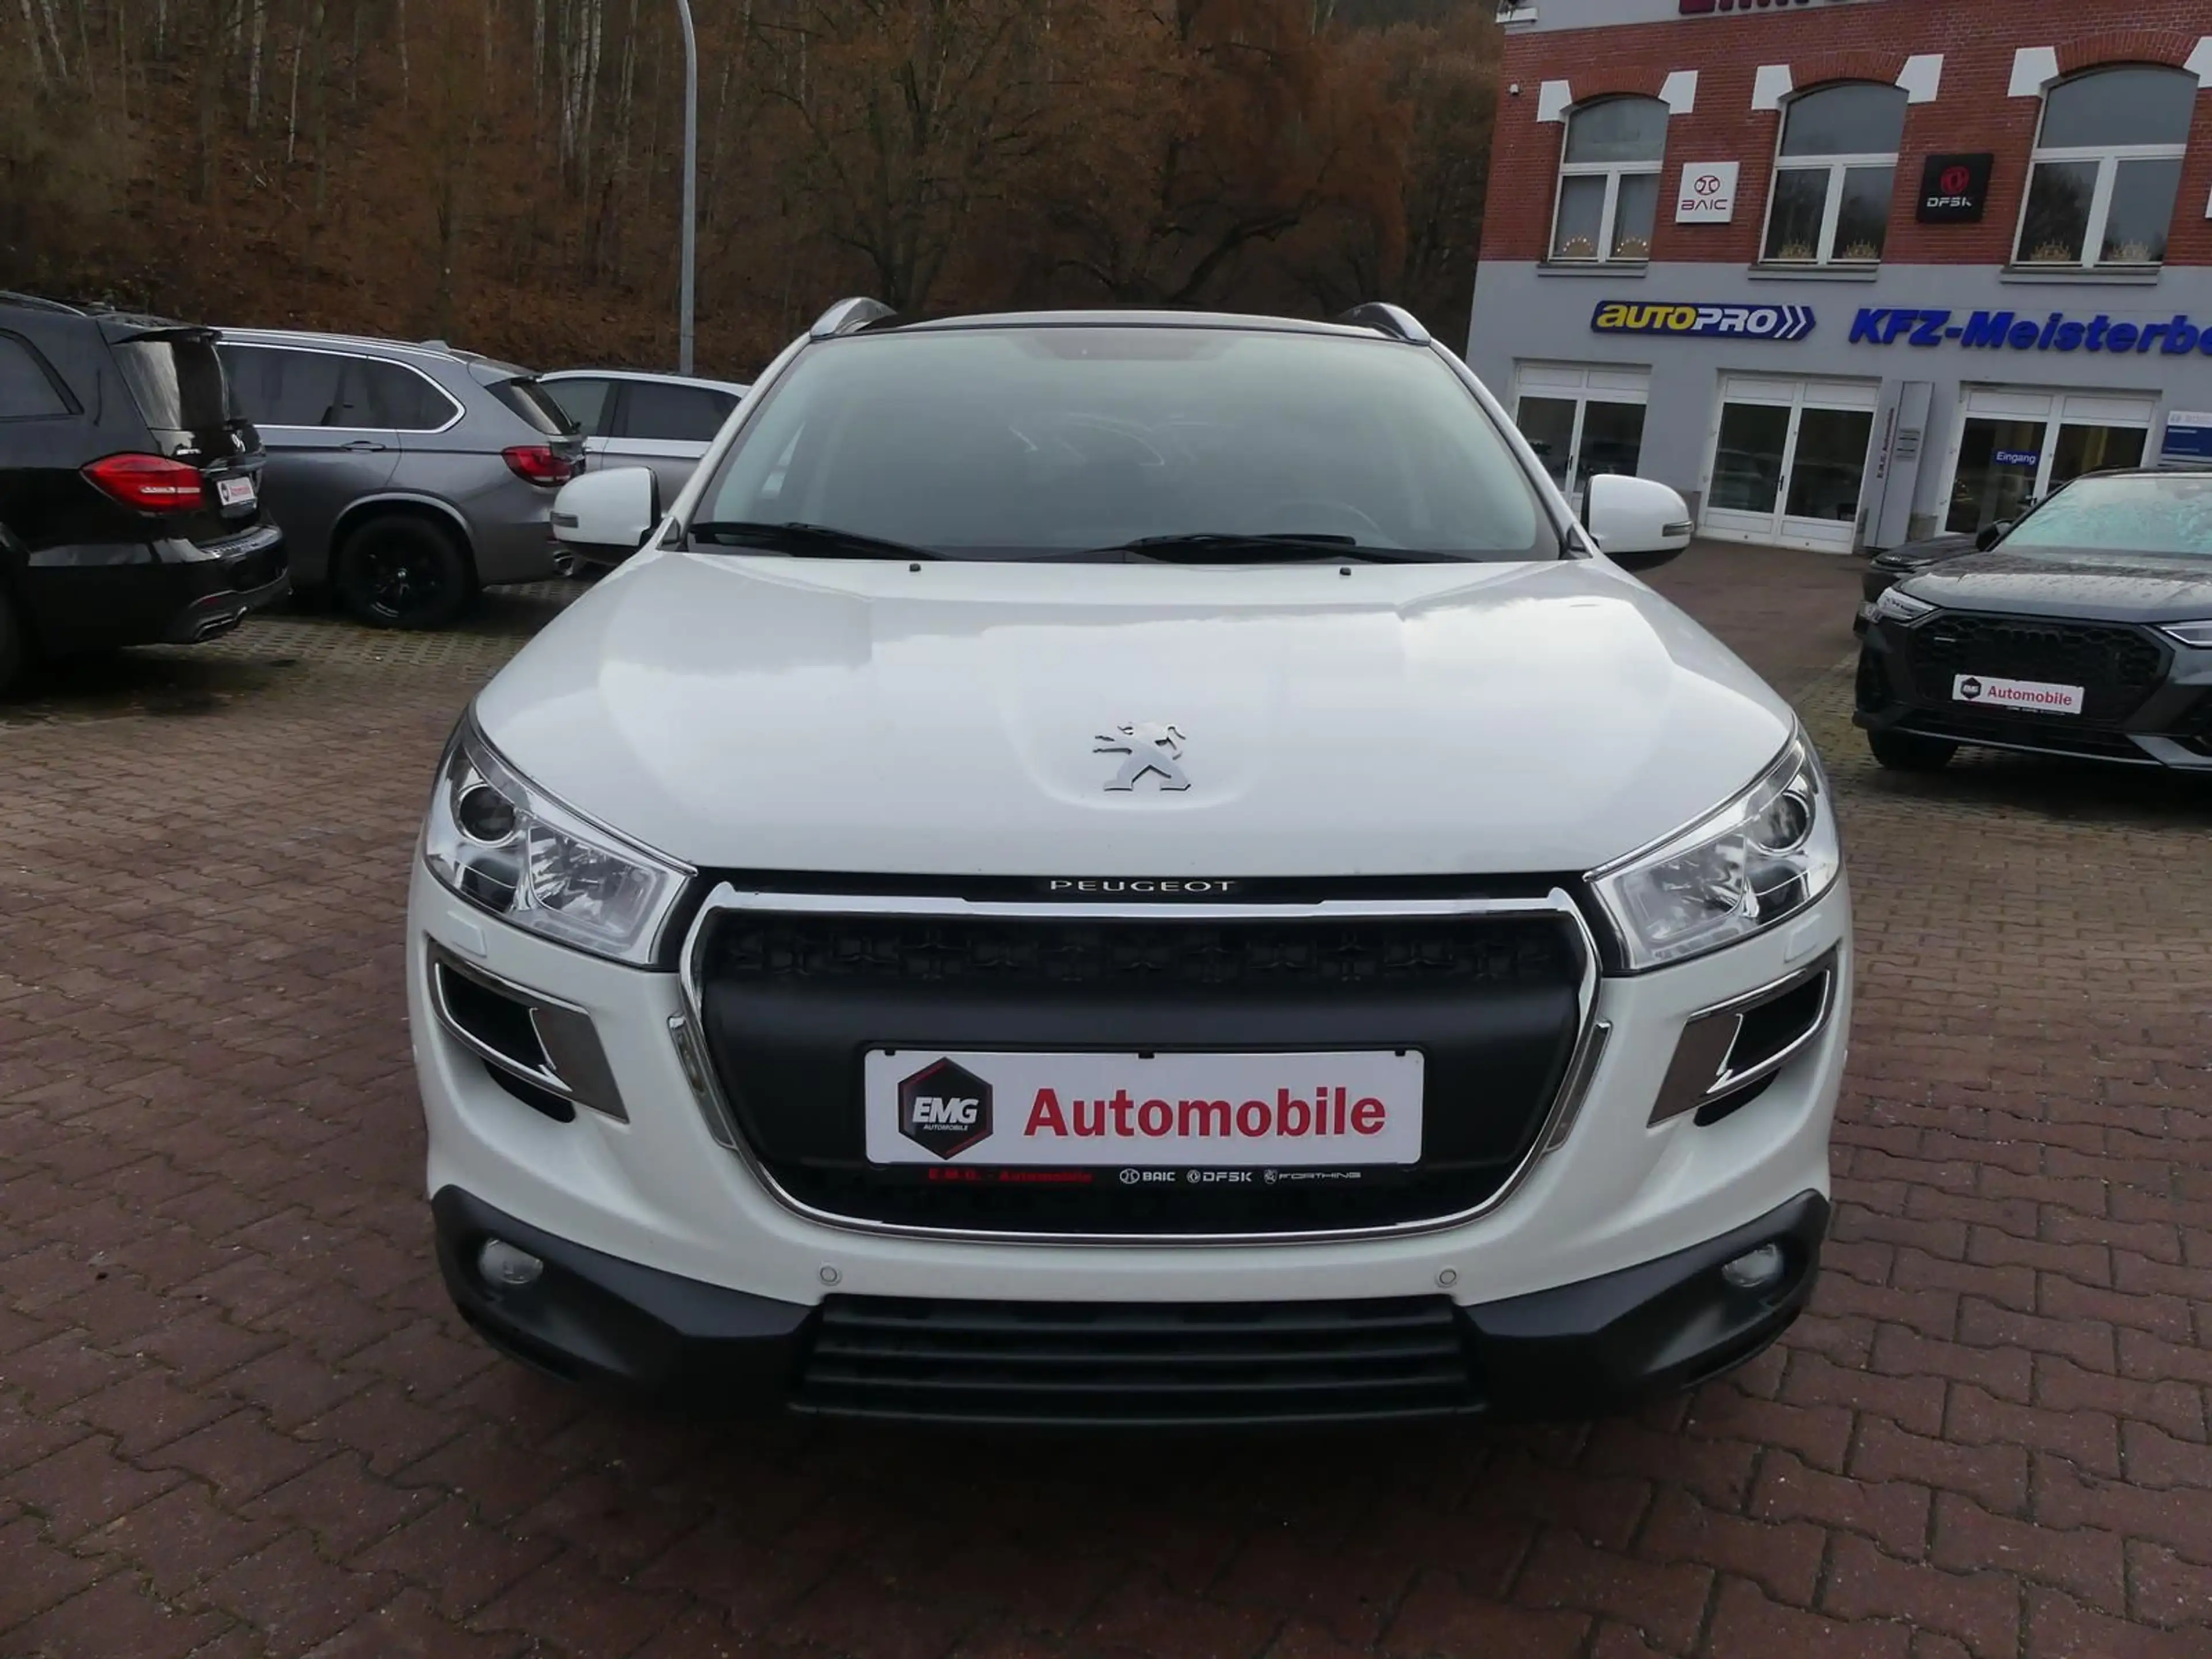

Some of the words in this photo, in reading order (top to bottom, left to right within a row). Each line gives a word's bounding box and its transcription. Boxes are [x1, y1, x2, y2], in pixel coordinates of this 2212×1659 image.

[1681, 199, 1728, 211] BAIC
[1926, 196, 1972, 207] DFSK
[1996, 451, 2036, 465] Eingang
[1987, 685, 2073, 706] Automobile
[1050, 880, 1237, 891] PEUGEOT
[912, 1096, 979, 1124] EMG
[1023, 1086, 1386, 1137] Automobile
[1142, 1172, 1176, 1181] BAIC
[1202, 1172, 1253, 1182] DFSK
